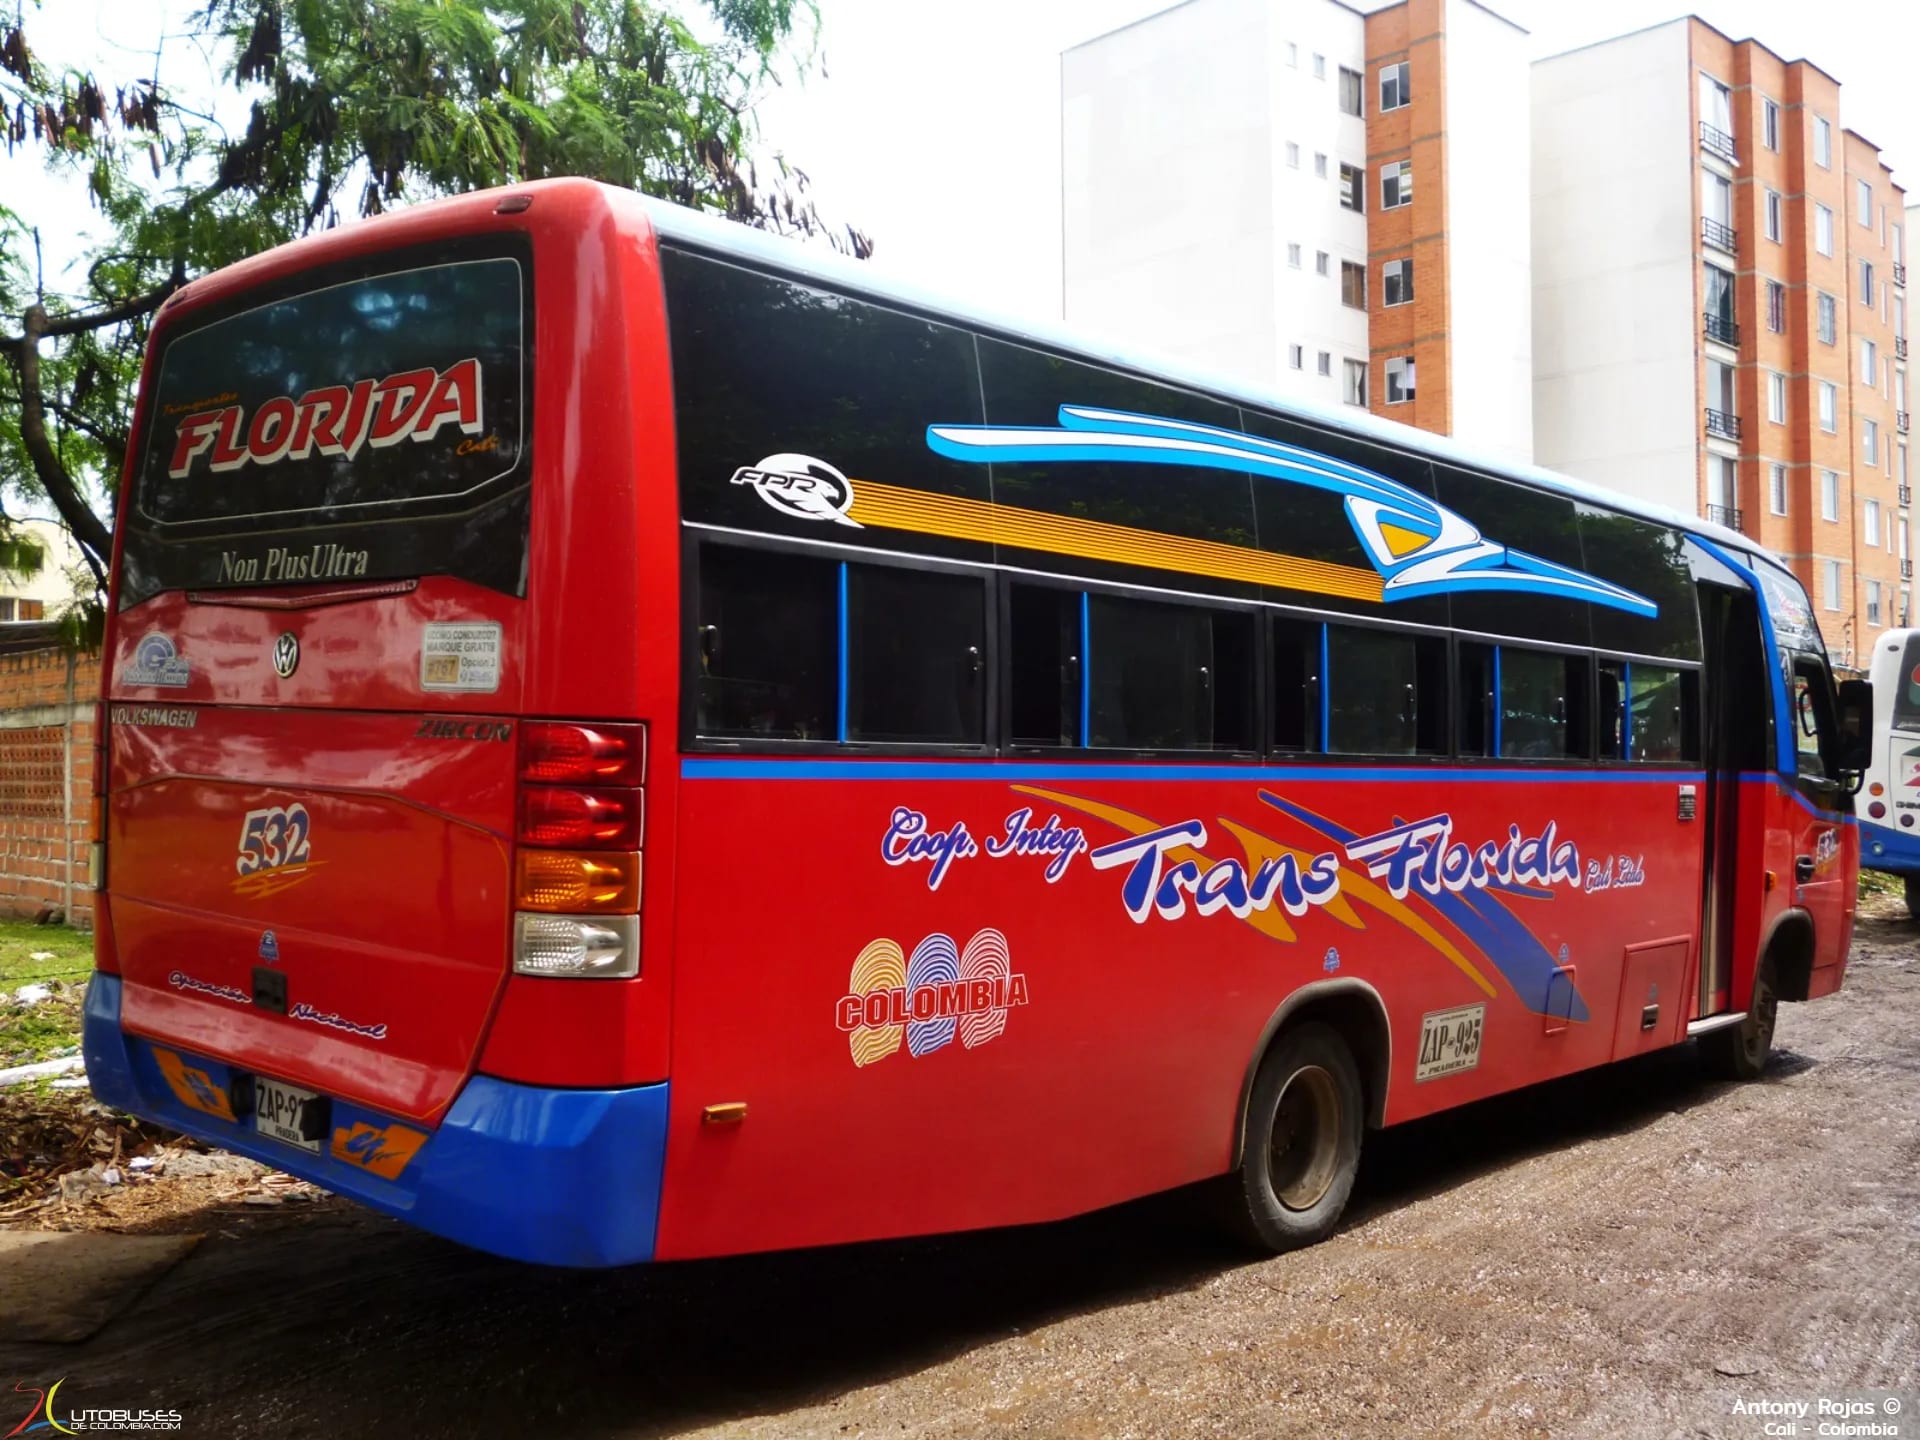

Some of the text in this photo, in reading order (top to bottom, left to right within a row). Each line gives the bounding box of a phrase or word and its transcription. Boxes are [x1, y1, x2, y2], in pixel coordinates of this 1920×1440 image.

[168, 358, 484, 479] FLORIDA
[730, 466, 817, 493] FPR
[217, 550, 258, 583] Non
[111, 707, 198, 729] VOLKSWAGEN
[415, 719, 513, 742] ZIRCON
[236, 803, 312, 878] 532
[882, 806, 1582, 924] Coop. Integ. Trans Florida
[1584, 858, 1611, 895] Cali
[169, 970, 388, 1039] Operación Nacional
[835, 973, 1030, 1032] COLOMBIA
